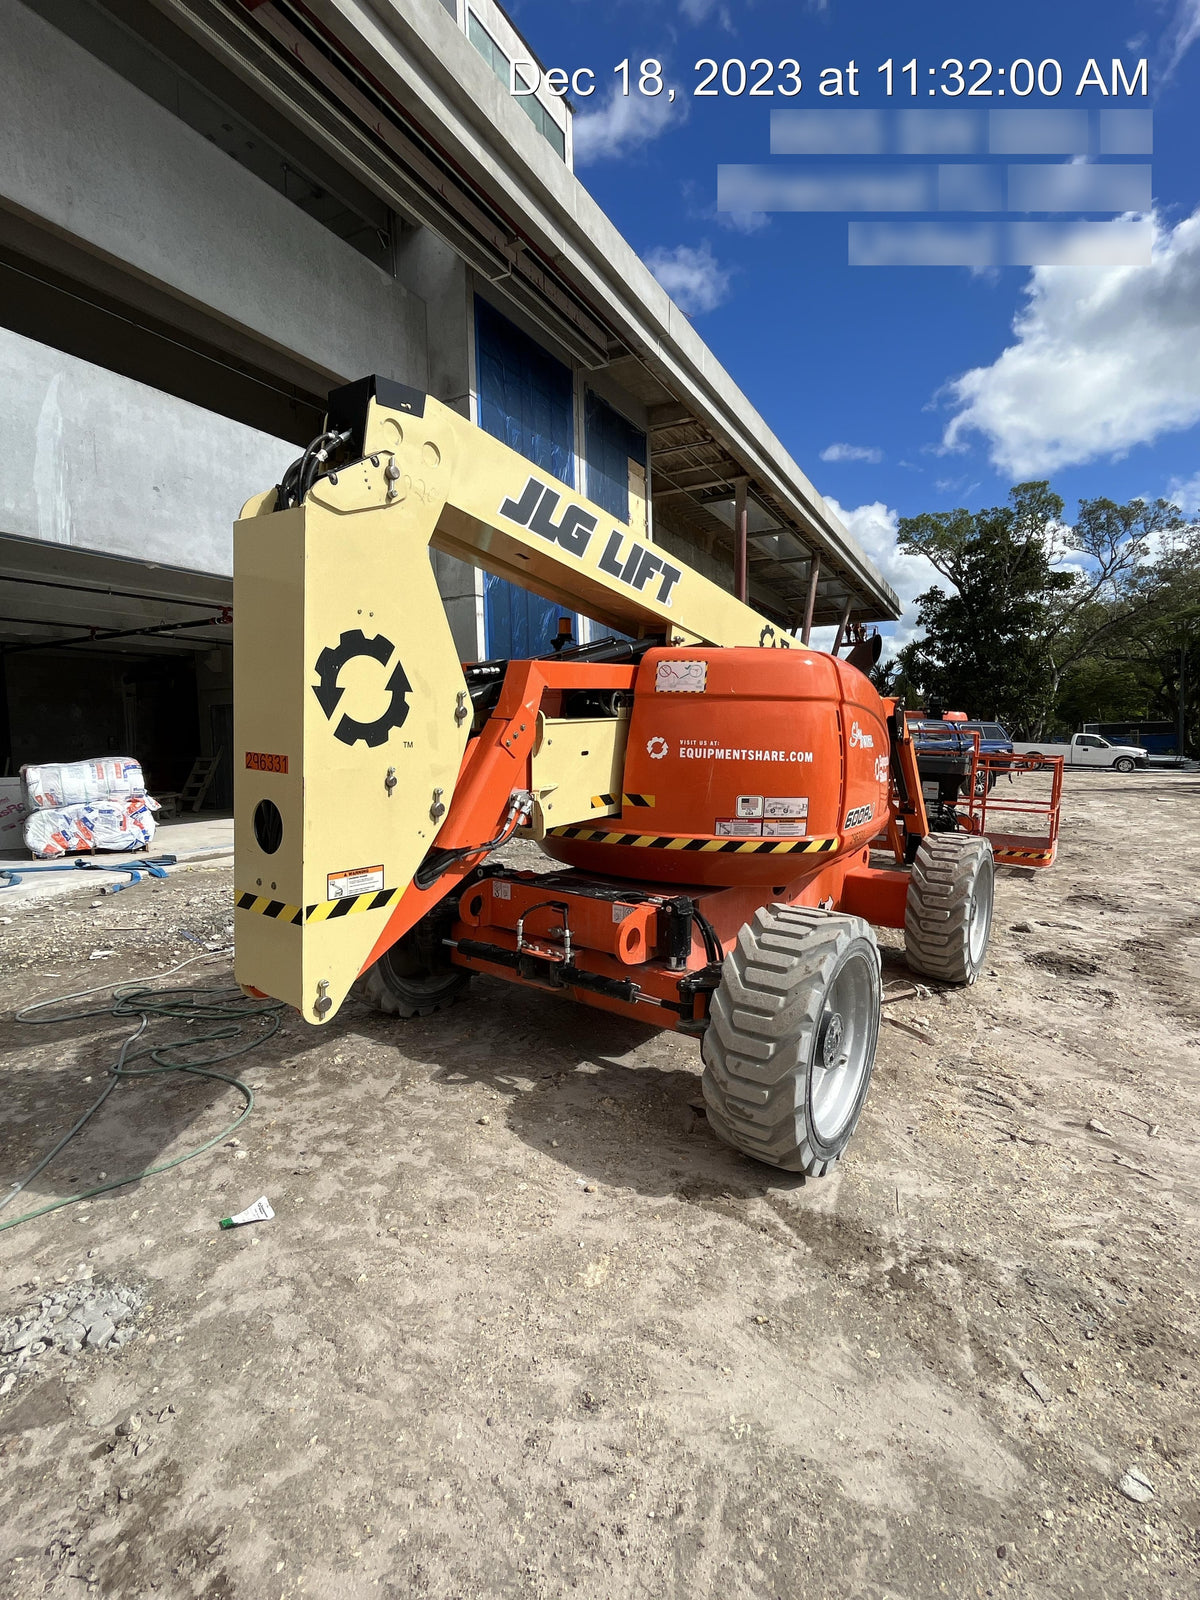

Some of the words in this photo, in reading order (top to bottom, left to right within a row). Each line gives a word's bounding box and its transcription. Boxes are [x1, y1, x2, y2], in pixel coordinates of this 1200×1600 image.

[499, 477, 598, 558] JLG
[598, 530, 682, 604] LIFT
[246, 752, 287, 774] 296331
[679, 747, 813, 763] EQUIPMENTSHARE.COM
